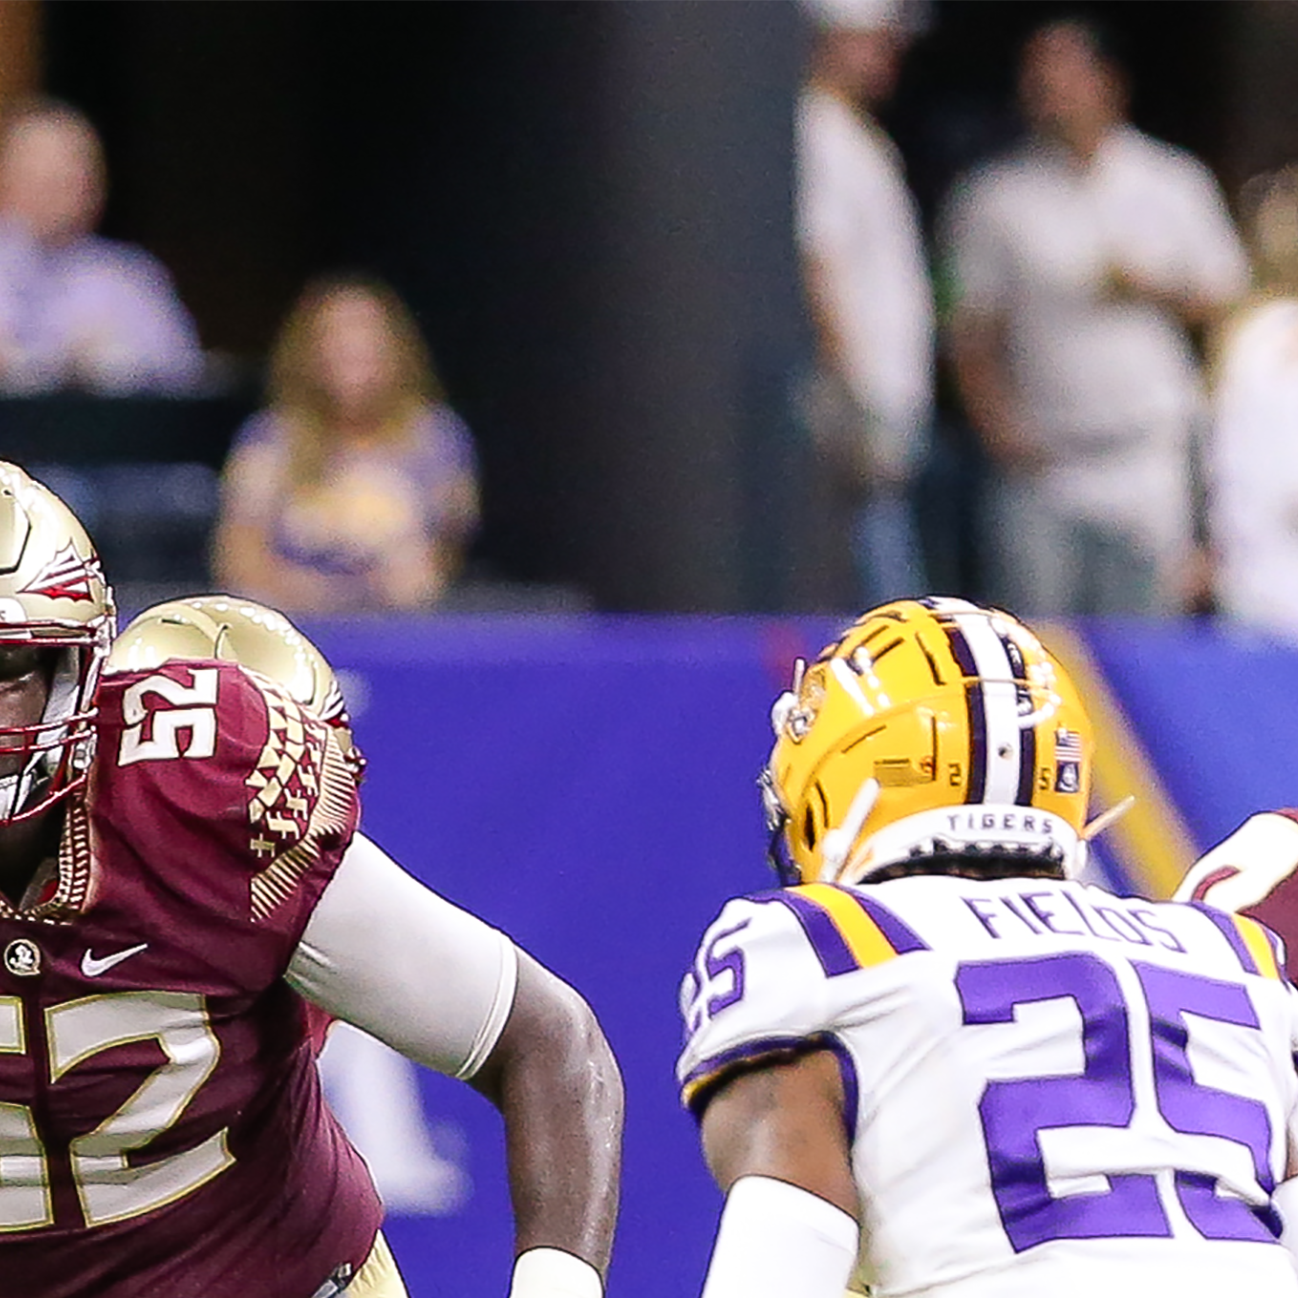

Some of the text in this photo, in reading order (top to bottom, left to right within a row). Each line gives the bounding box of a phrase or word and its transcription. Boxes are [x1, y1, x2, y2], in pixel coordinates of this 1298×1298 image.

[117, 668, 219, 767] 52
[947, 813, 1053, 835] TIGERS
[960, 890, 1188, 954] FIELDS
[953, 950, 1284, 1254] 25
